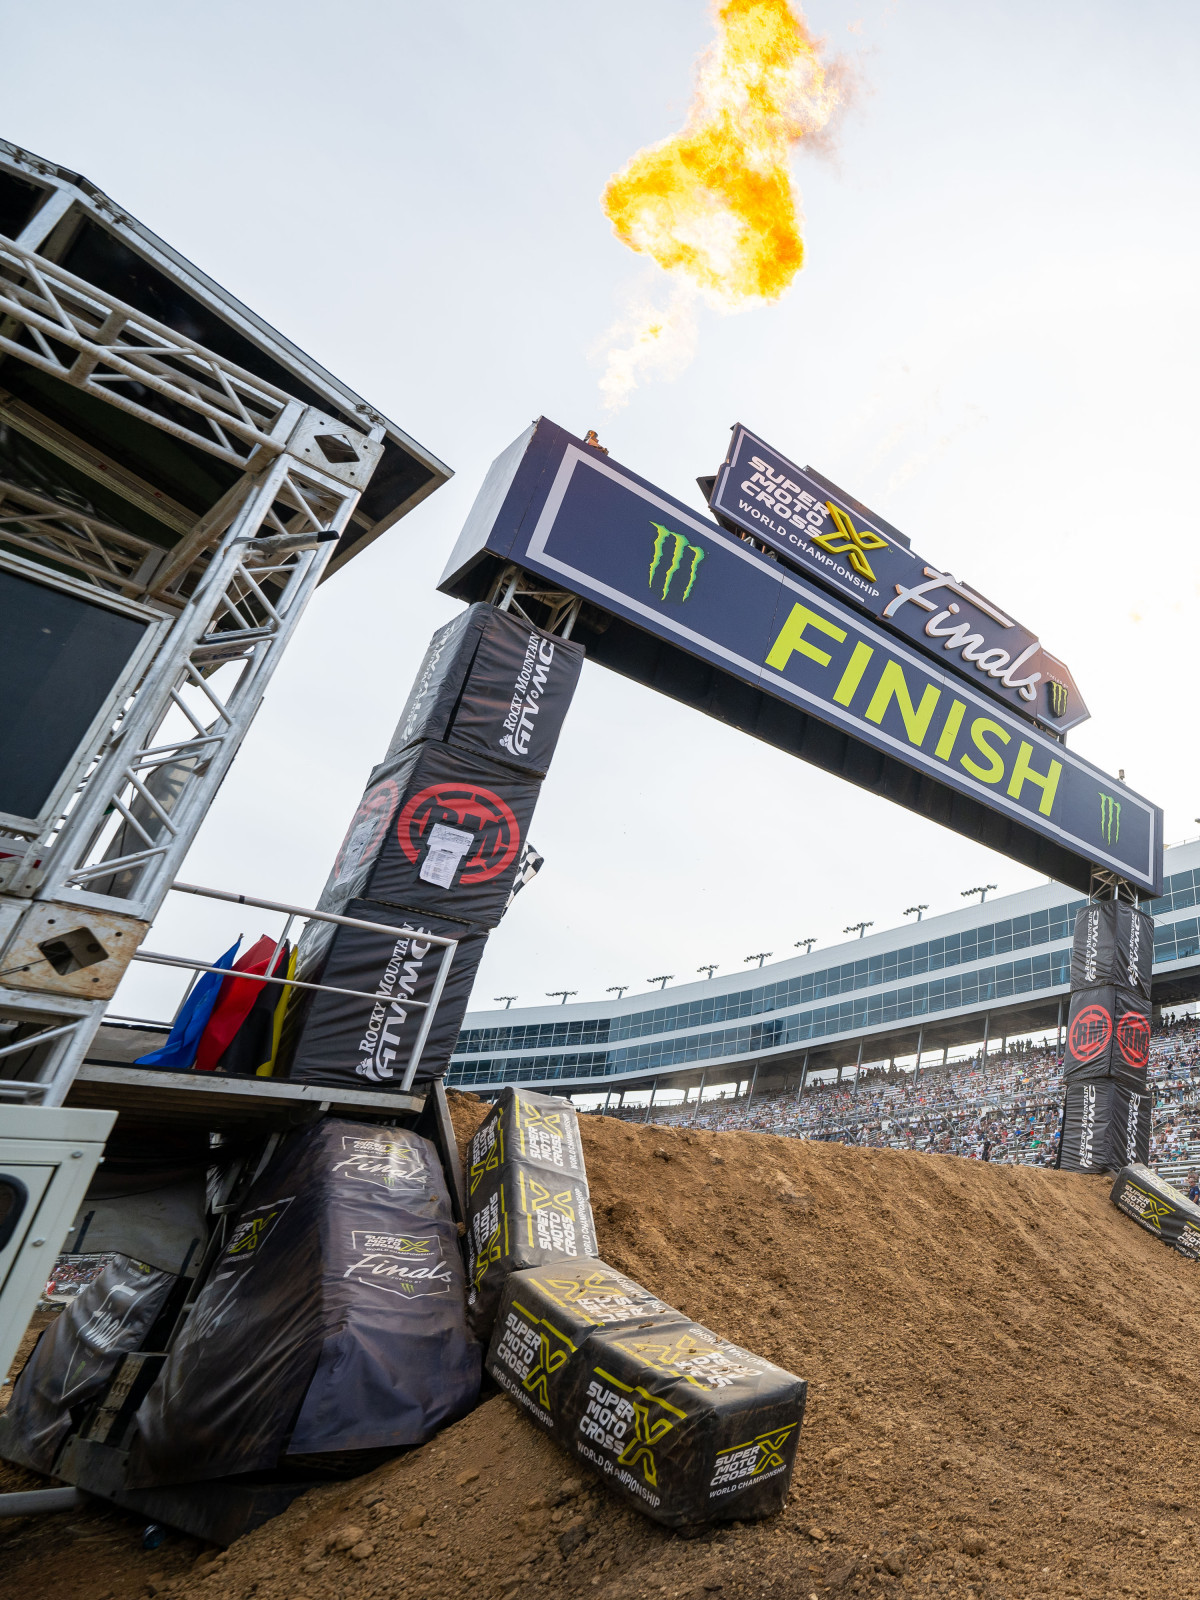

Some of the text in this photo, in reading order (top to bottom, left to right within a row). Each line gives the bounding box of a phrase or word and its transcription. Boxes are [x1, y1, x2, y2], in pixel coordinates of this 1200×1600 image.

[747, 455, 831, 519] SUPER
[750, 472, 824, 527] MOTO
[740, 480, 823, 538] CROSS
[738, 498, 880, 598] WORLD CHAMPIONSHIP
[882, 566, 1042, 702] Finals
[503, 631, 541, 733] ROCKY MOUNTAIN
[765, 601, 1062, 817] FINISH
[358, 921, 415, 1055] ROCKY MOUNTAN
[528, 1126, 541, 1160] SUPER
[540, 1131, 553, 1161] MOTO
[550, 1133, 564, 1167] CROSS
[562, 1113, 576, 1149] CHAMPIONSHIP
[332, 1154, 429, 1184] Finals
[489, 1192, 498, 1236] SUPER
[575, 1188, 590, 1235] CHAMPIONSHIP
[1120, 1195, 1146, 1214] CROSS
[1124, 1184, 1150, 1205] SUPER
[1124, 1191, 1147, 1209] MOTO
[473, 1212, 483, 1255] CROSS
[480, 1202, 490, 1244] MOTO
[536, 1208, 553, 1251] SUPER
[550, 1211, 564, 1252] MOTO
[561, 1215, 577, 1257] CROSS
[343, 1253, 452, 1282] Finals
[502, 1329, 535, 1365] MOTO
[505, 1312, 543, 1351] SUPER
[496, 1343, 531, 1381] CROSS
[492, 1365, 554, 1428] WORLD CHAMPIONSHIP
[586, 1380, 635, 1423] SUPER
[579, 1415, 626, 1455] CROSS
[586, 1400, 627, 1438] MOTO
[577, 1440, 661, 1508] WORLD CHAMPIONSHIP
[710, 1466, 756, 1487] CROSS
[714, 1445, 761, 1468] SUPER
[716, 1456, 756, 1476] MOTO
[709, 1464, 787, 1498] WORLD CHAMPIONSHIP
